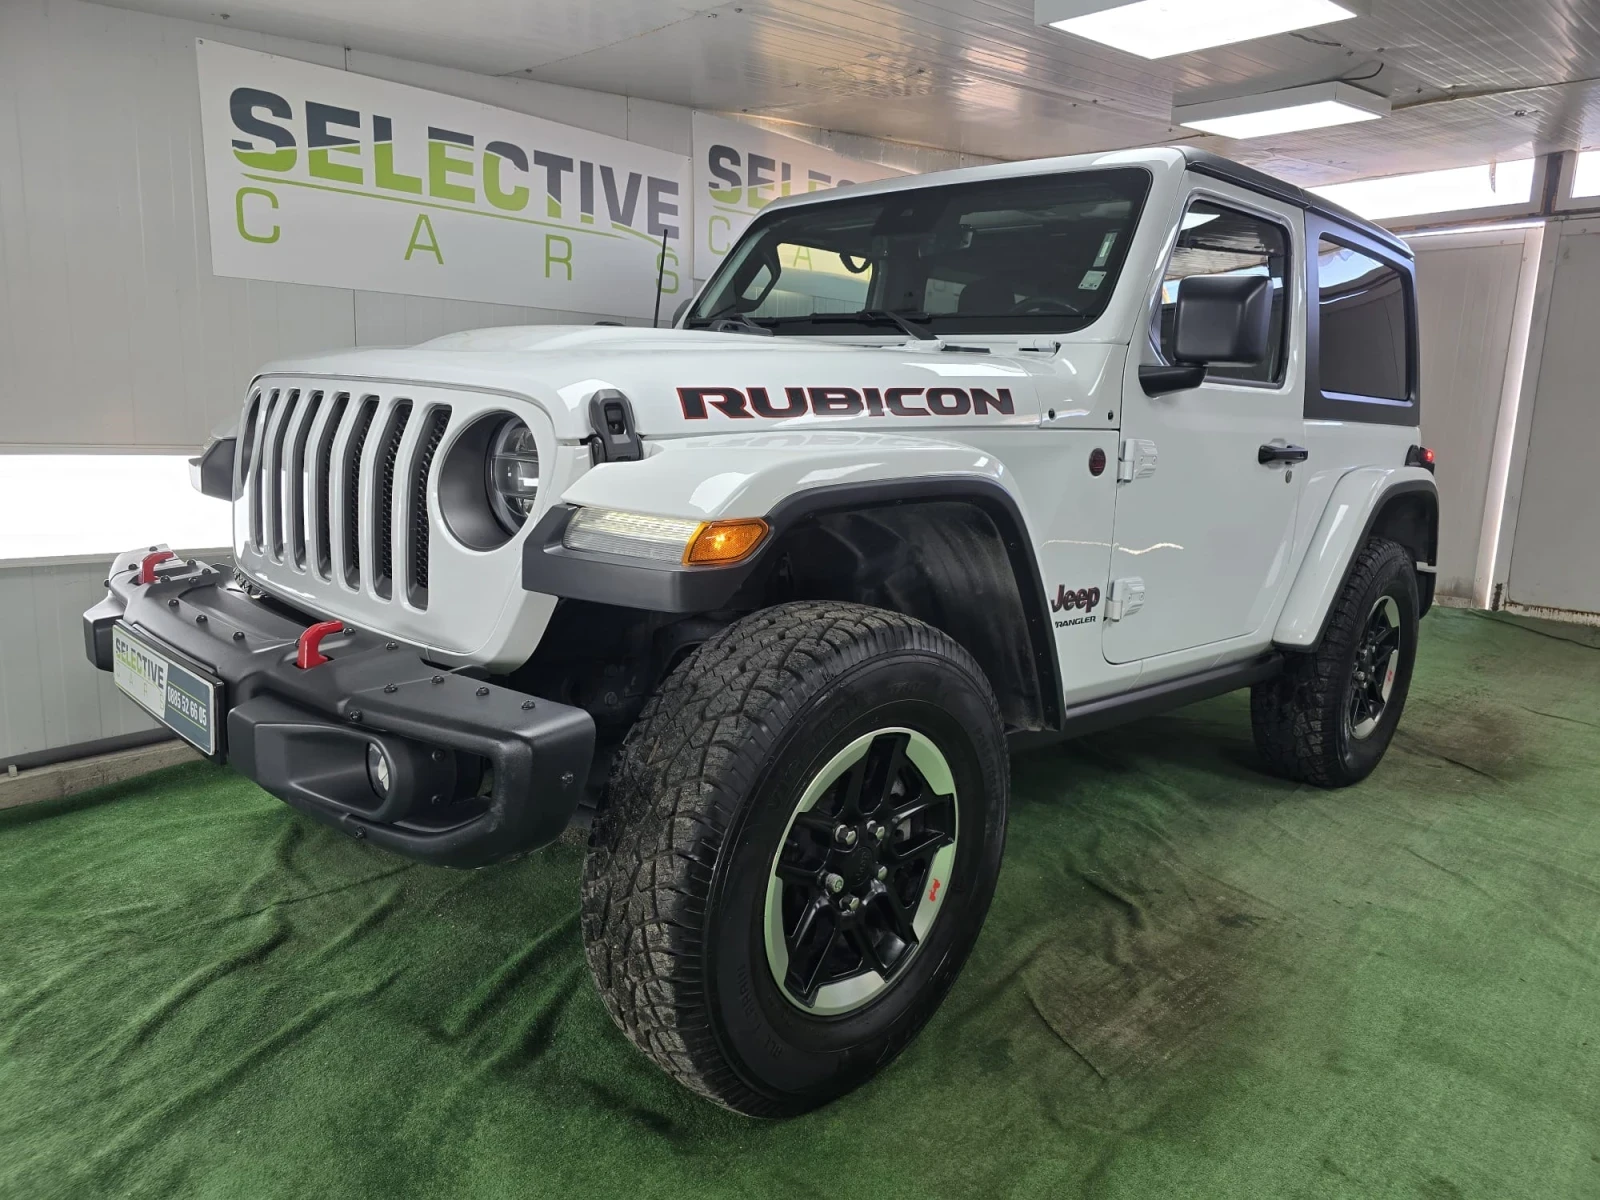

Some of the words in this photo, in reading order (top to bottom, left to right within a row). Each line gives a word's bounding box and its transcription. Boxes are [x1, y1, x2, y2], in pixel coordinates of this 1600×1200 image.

[230, 87, 679, 239] SELECTIVE
[235, 187, 679, 294] CARS
[676, 387, 1015, 420] RUBICON
[1051, 585, 1100, 613] Jeep
[115, 638, 164, 690] SELECTIVE
[167, 686, 181, 709] 0885
[181, 695, 190, 715] 52
[190, 700, 199, 720] 66
[198, 706, 207, 726] 05
